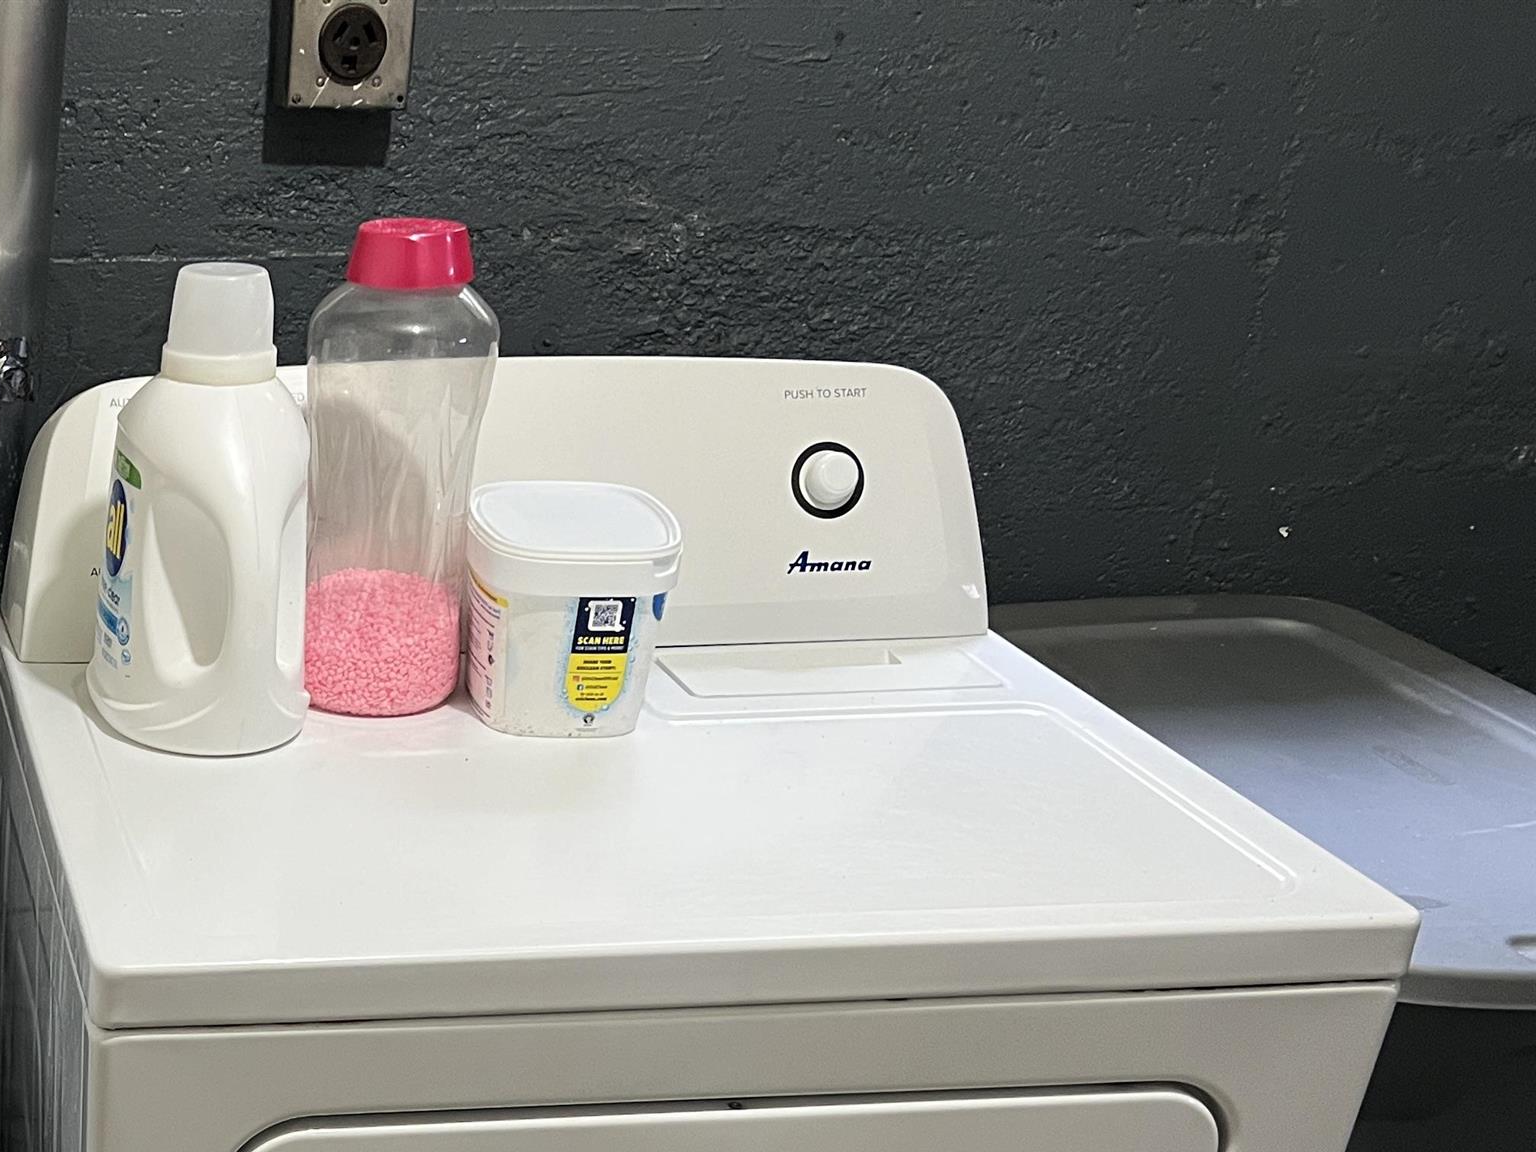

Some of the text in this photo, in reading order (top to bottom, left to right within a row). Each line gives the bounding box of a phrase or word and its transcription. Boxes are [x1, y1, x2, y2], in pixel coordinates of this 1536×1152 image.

[784, 387, 867, 400] PUSH TO START
[107, 501, 125, 559] all
[787, 550, 872, 575] Amana
[577, 636, 625, 645] SCAN HERE
